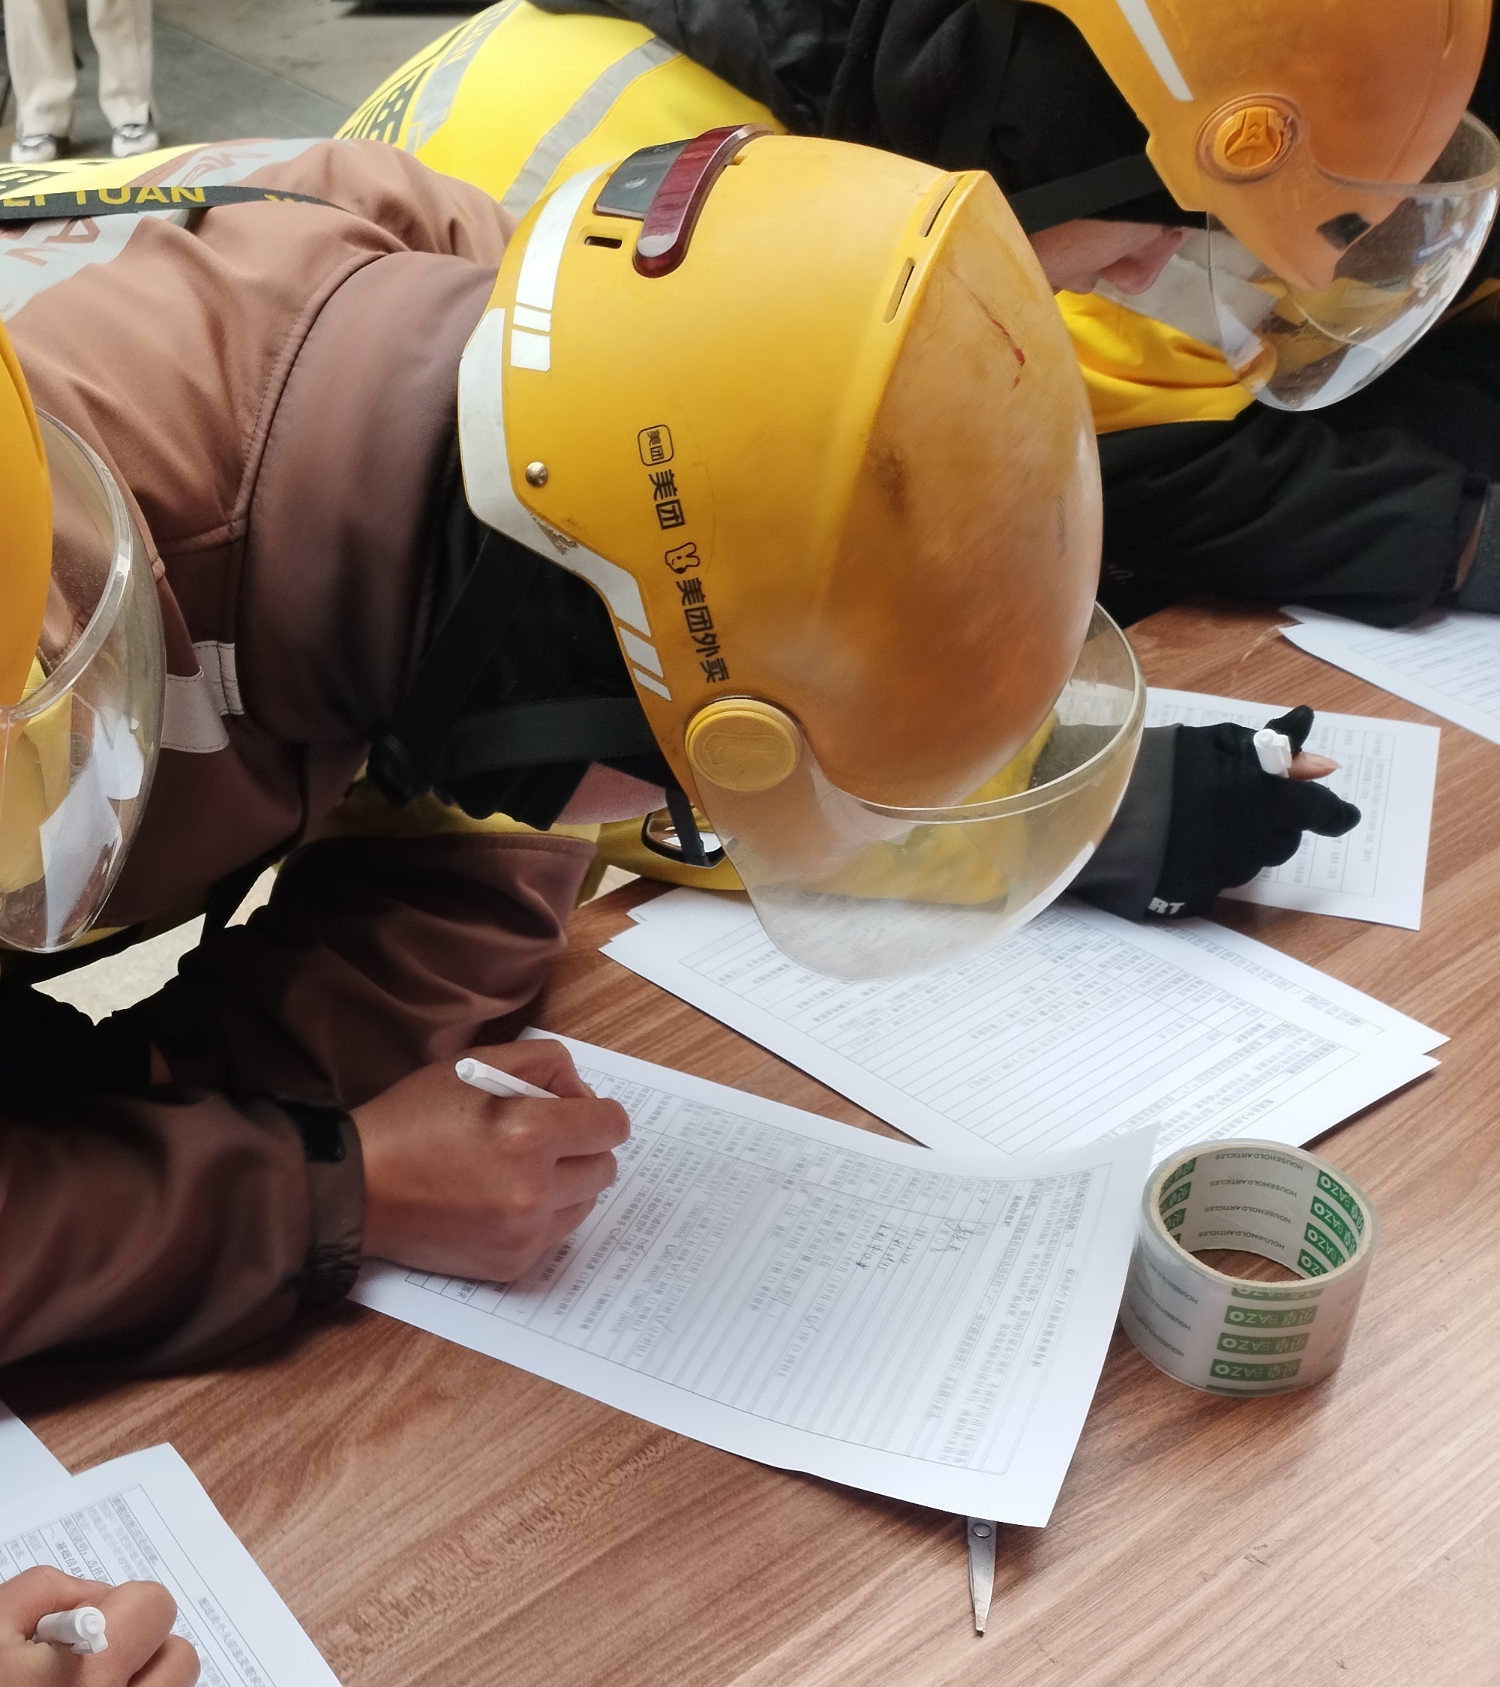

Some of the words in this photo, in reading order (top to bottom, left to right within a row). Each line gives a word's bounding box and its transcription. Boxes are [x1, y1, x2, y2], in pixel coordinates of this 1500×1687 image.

[648, 469, 686, 530] 美团
[676, 577, 730, 684] 美团外卖
[1253, 1153, 1304, 1171] HOUSEHOLD
[1209, 1179, 1247, 1187] ARTICLES
[1247, 1180, 1297, 1197] HOUSEHOLD
[1203, 1204, 1241, 1213] ARTICLES
[1241, 1205, 1291, 1224] HOUSEHOLD
[1235, 1231, 1285, 1250] HOUSEHOLD
[1228, 1310, 1278, 1325] BAZO
[1221, 1337, 1271, 1351] BAZO
[1214, 1363, 1262, 1378] BAZO
